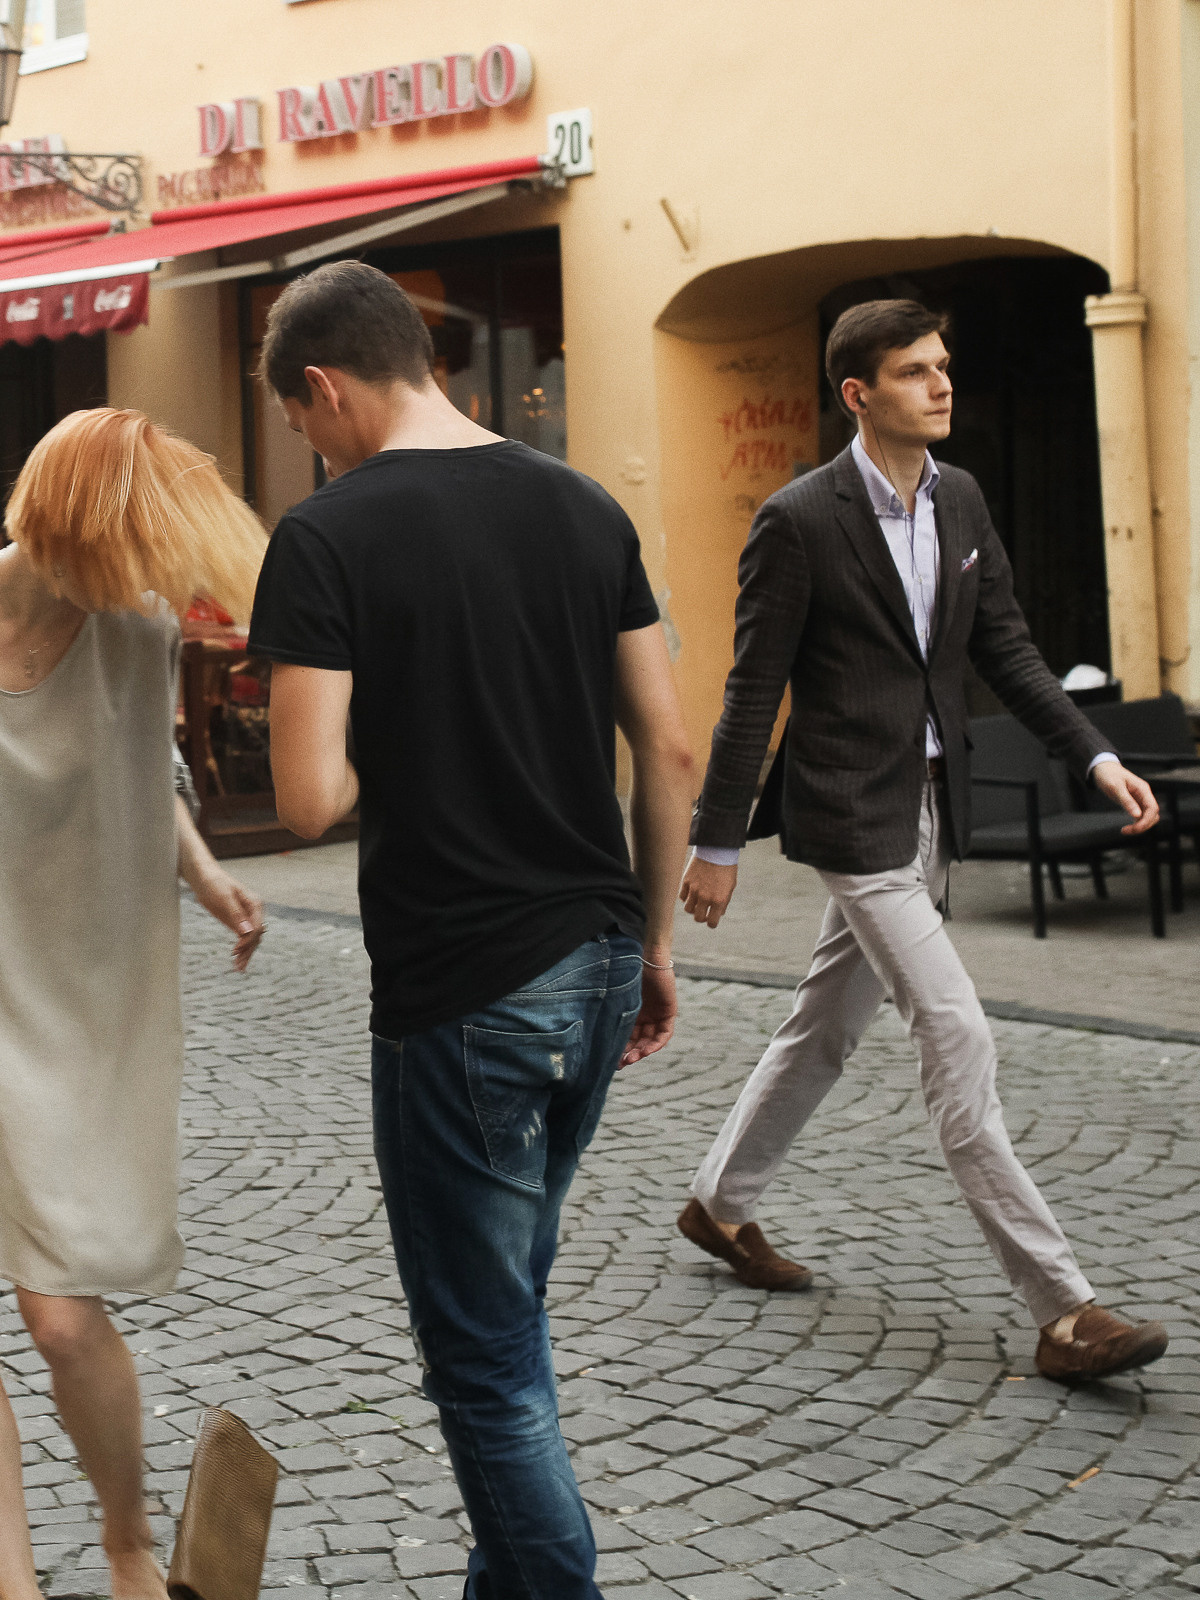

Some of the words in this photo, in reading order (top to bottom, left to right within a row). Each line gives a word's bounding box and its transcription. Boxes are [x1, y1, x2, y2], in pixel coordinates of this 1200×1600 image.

[197, 98, 262, 158] DI
[275, 43, 532, 143] RAVELLO
[554, 121, 582, 167] 20
